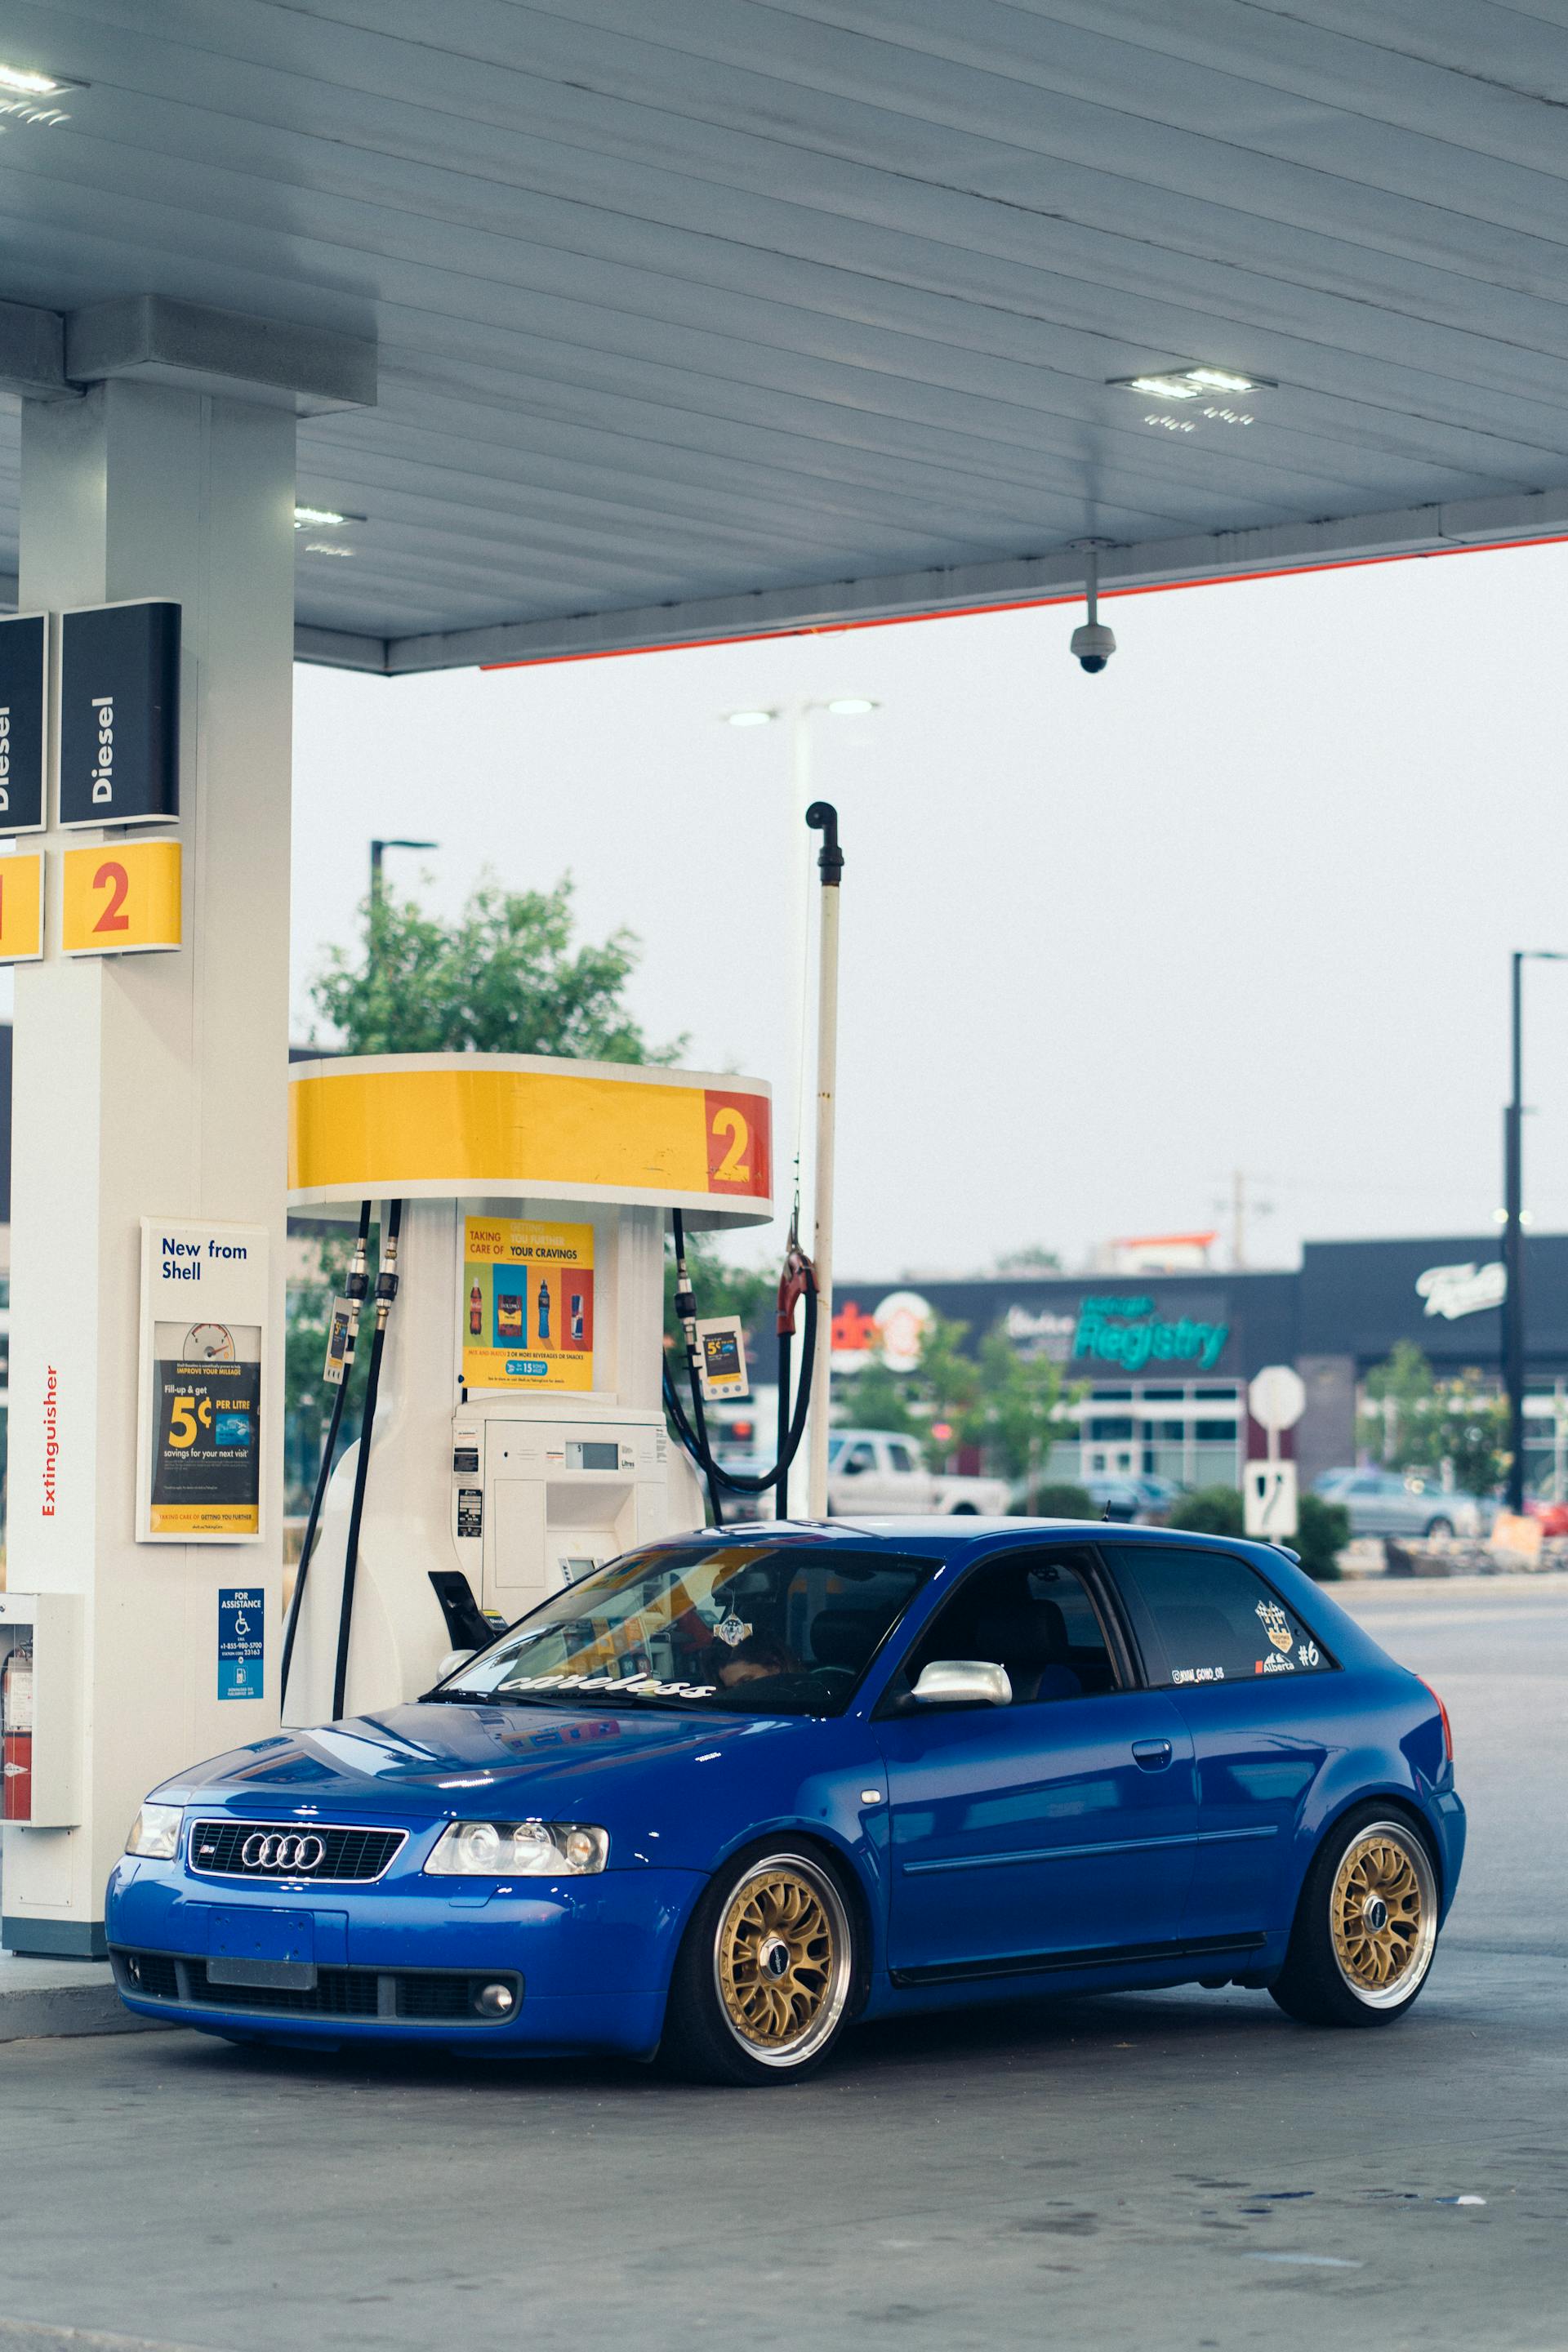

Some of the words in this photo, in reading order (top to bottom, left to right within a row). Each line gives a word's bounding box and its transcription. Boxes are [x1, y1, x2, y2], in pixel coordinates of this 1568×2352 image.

[91, 697, 113, 804] Diesel
[92, 862, 129, 933] 2
[712, 1107, 750, 1182] 2
[470, 1231, 501, 1241] TAKING
[163, 1238, 201, 1256] New
[209, 1240, 247, 1259] from
[470, 1244, 490, 1254] CARE
[493, 1245, 504, 1255] OF
[510, 1246, 533, 1257] YOUR
[536, 1248, 577, 1259] CRAVINGS
[163, 1261, 200, 1280] Shell
[523, 1363, 532, 1373] 15
[164, 1385, 186, 1396] Fill-up
[187, 1385, 194, 1393] &
[195, 1387, 207, 1396] get
[216, 1400, 230, 1410] PER
[233, 1400, 250, 1410] LITRE
[42, 1365, 59, 1517] Extinguisher
[164, 1449, 189, 1459] savings
[190, 1448, 201, 1457] for
[202, 1450, 217, 1459] your
[234, 1592, 248, 1601] FOR
[221, 1600, 261, 1609] ASSISTANCE
[1298, 1640, 1319, 1666] #6
[1263, 1663, 1295, 1673] Alberta
[497, 1673, 717, 1699] careless
